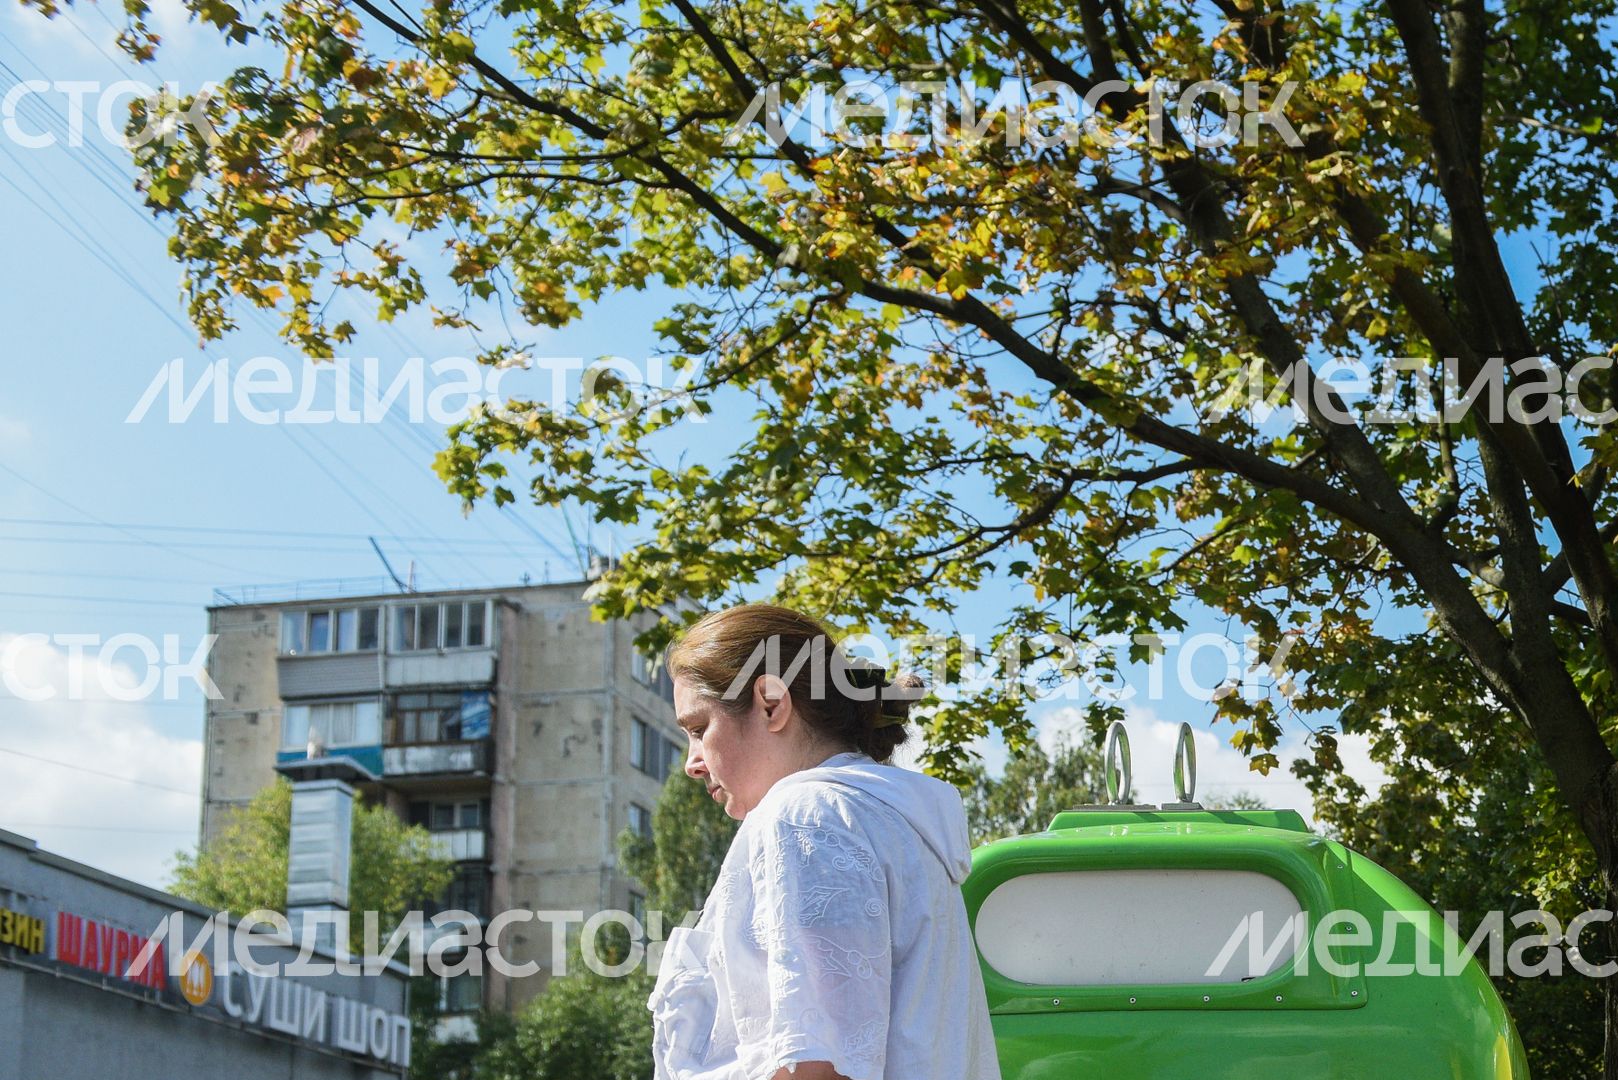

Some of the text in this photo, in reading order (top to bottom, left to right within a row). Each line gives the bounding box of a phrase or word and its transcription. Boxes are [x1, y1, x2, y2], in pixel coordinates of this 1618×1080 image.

[57, 911, 167, 991] ШАУРМА
[223, 960, 326, 1044] СУШИ
[338, 997, 411, 1068] ШОП
